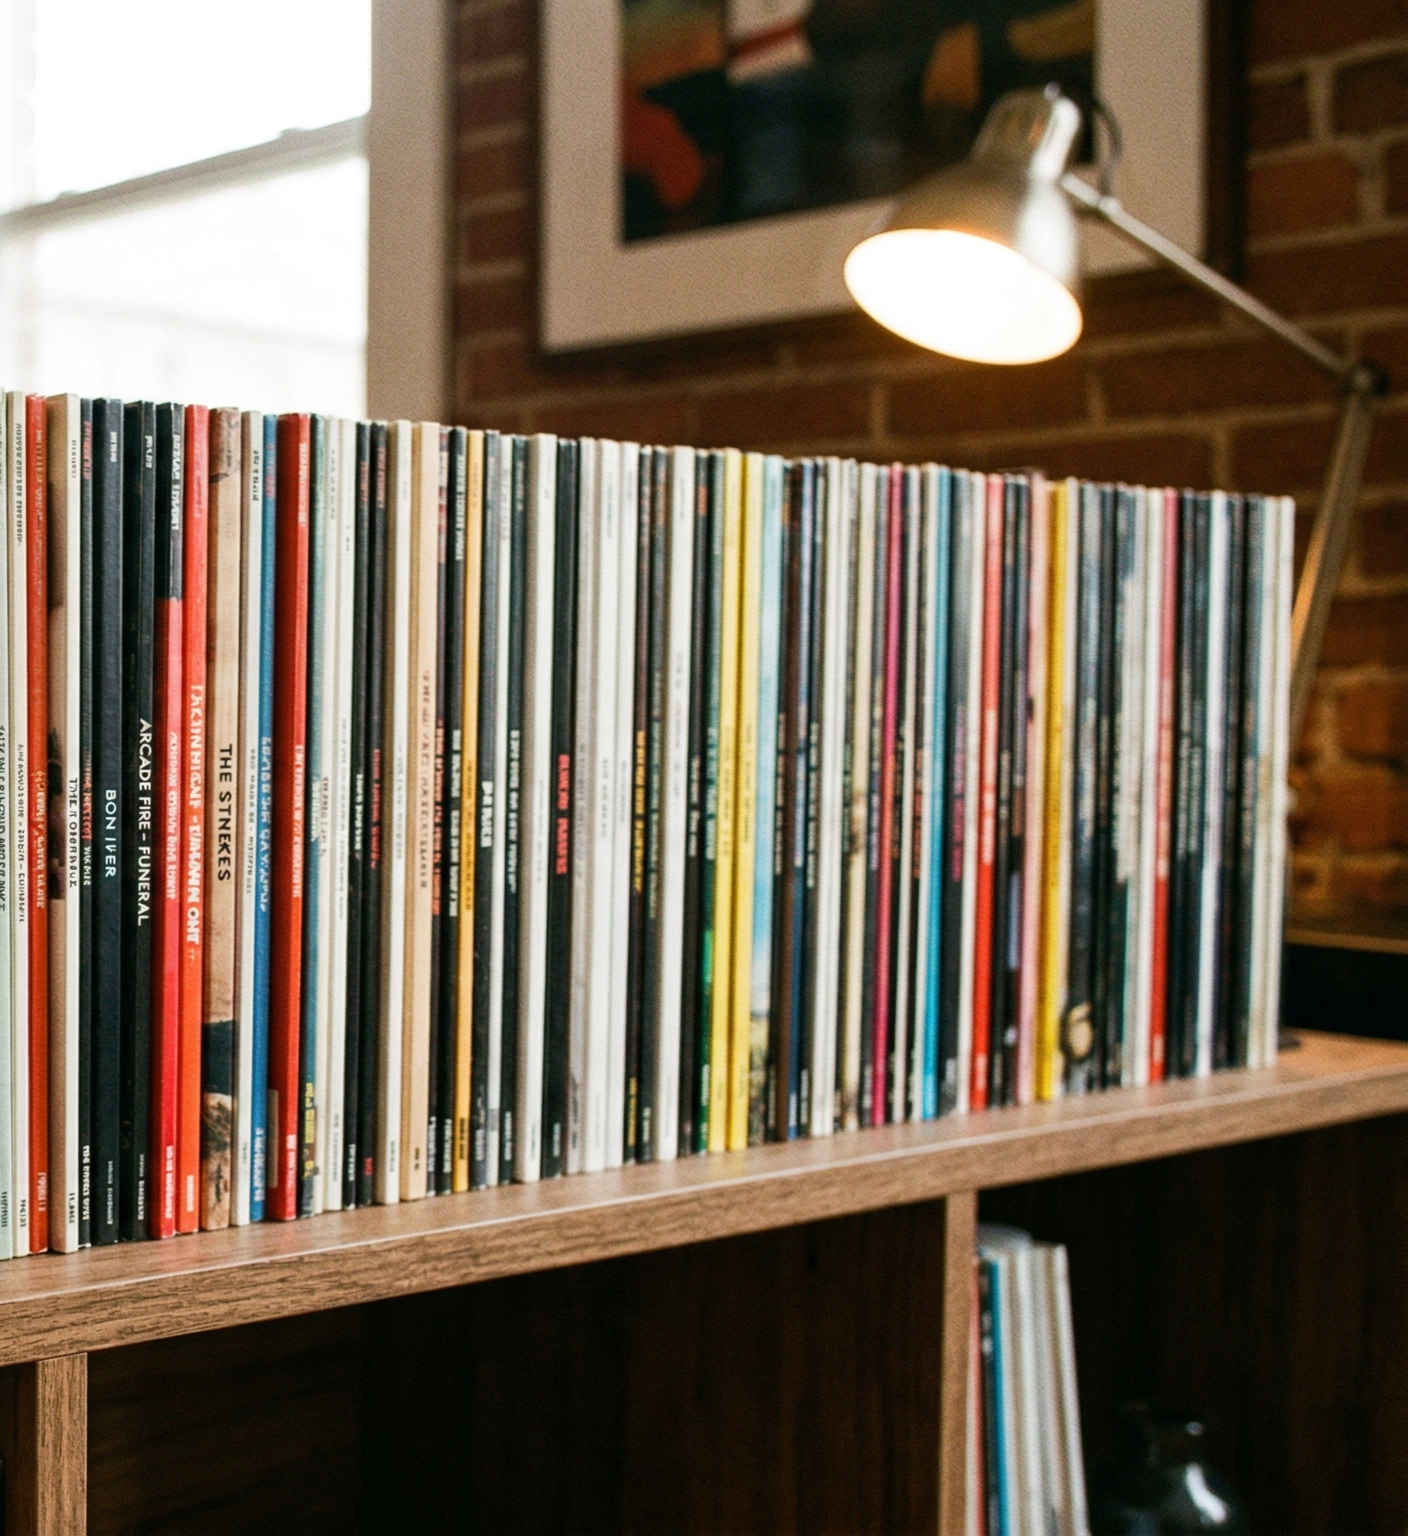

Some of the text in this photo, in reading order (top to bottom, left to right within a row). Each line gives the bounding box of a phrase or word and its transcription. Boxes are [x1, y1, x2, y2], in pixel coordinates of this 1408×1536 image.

[138, 718, 152, 790] ARCADE
[219, 744, 233, 782] THE
[105, 790, 117, 830] BON
[138, 796, 151, 831] FIRE
[137, 846, 151, 927] FUNERAL
